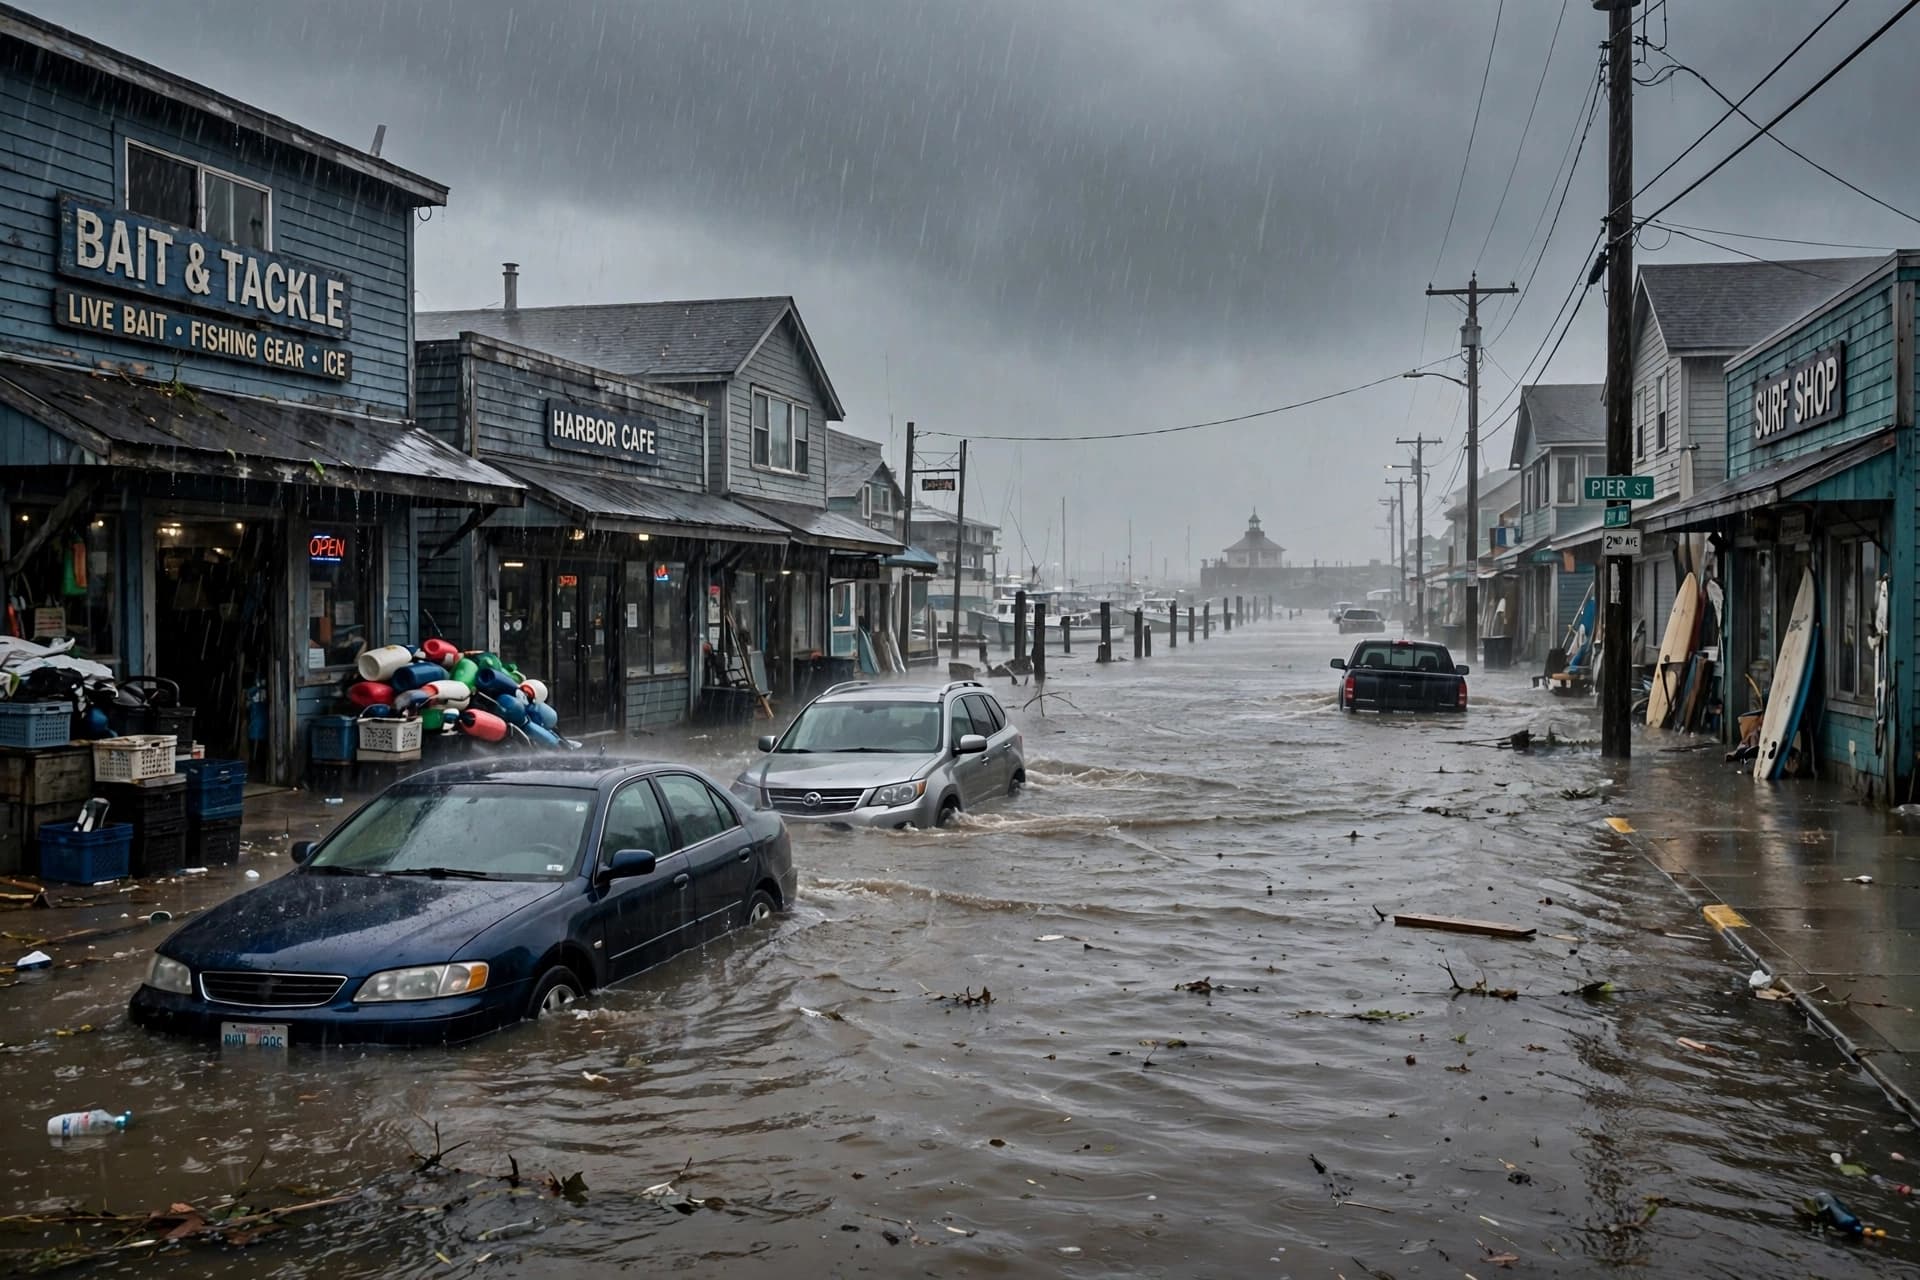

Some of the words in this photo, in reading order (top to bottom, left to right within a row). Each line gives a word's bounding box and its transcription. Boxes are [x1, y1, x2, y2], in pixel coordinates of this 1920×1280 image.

[76, 207, 173, 285] BAIT
[184, 242, 210, 295] &
[220, 248, 344, 328] TACKLE
[68, 293, 114, 330] LIVE
[123, 305, 167, 339] BAIT
[191, 321, 257, 358] FISHING
[264, 337, 304, 368] GEAR
[323, 349, 345, 377] ICE
[1755, 379, 1789, 439] SURF
[1794, 357, 1837, 423] SHOP
[554, 410, 616, 447] HARBOR
[622, 425, 655, 454] CAFE
[1592, 480, 1626, 496] PIER
[1635, 483, 1648, 496] ST
[310, 538, 345, 557] OPEN
[1606, 536, 1623, 549] 2ND
[1626, 536, 1638, 547] AVE
